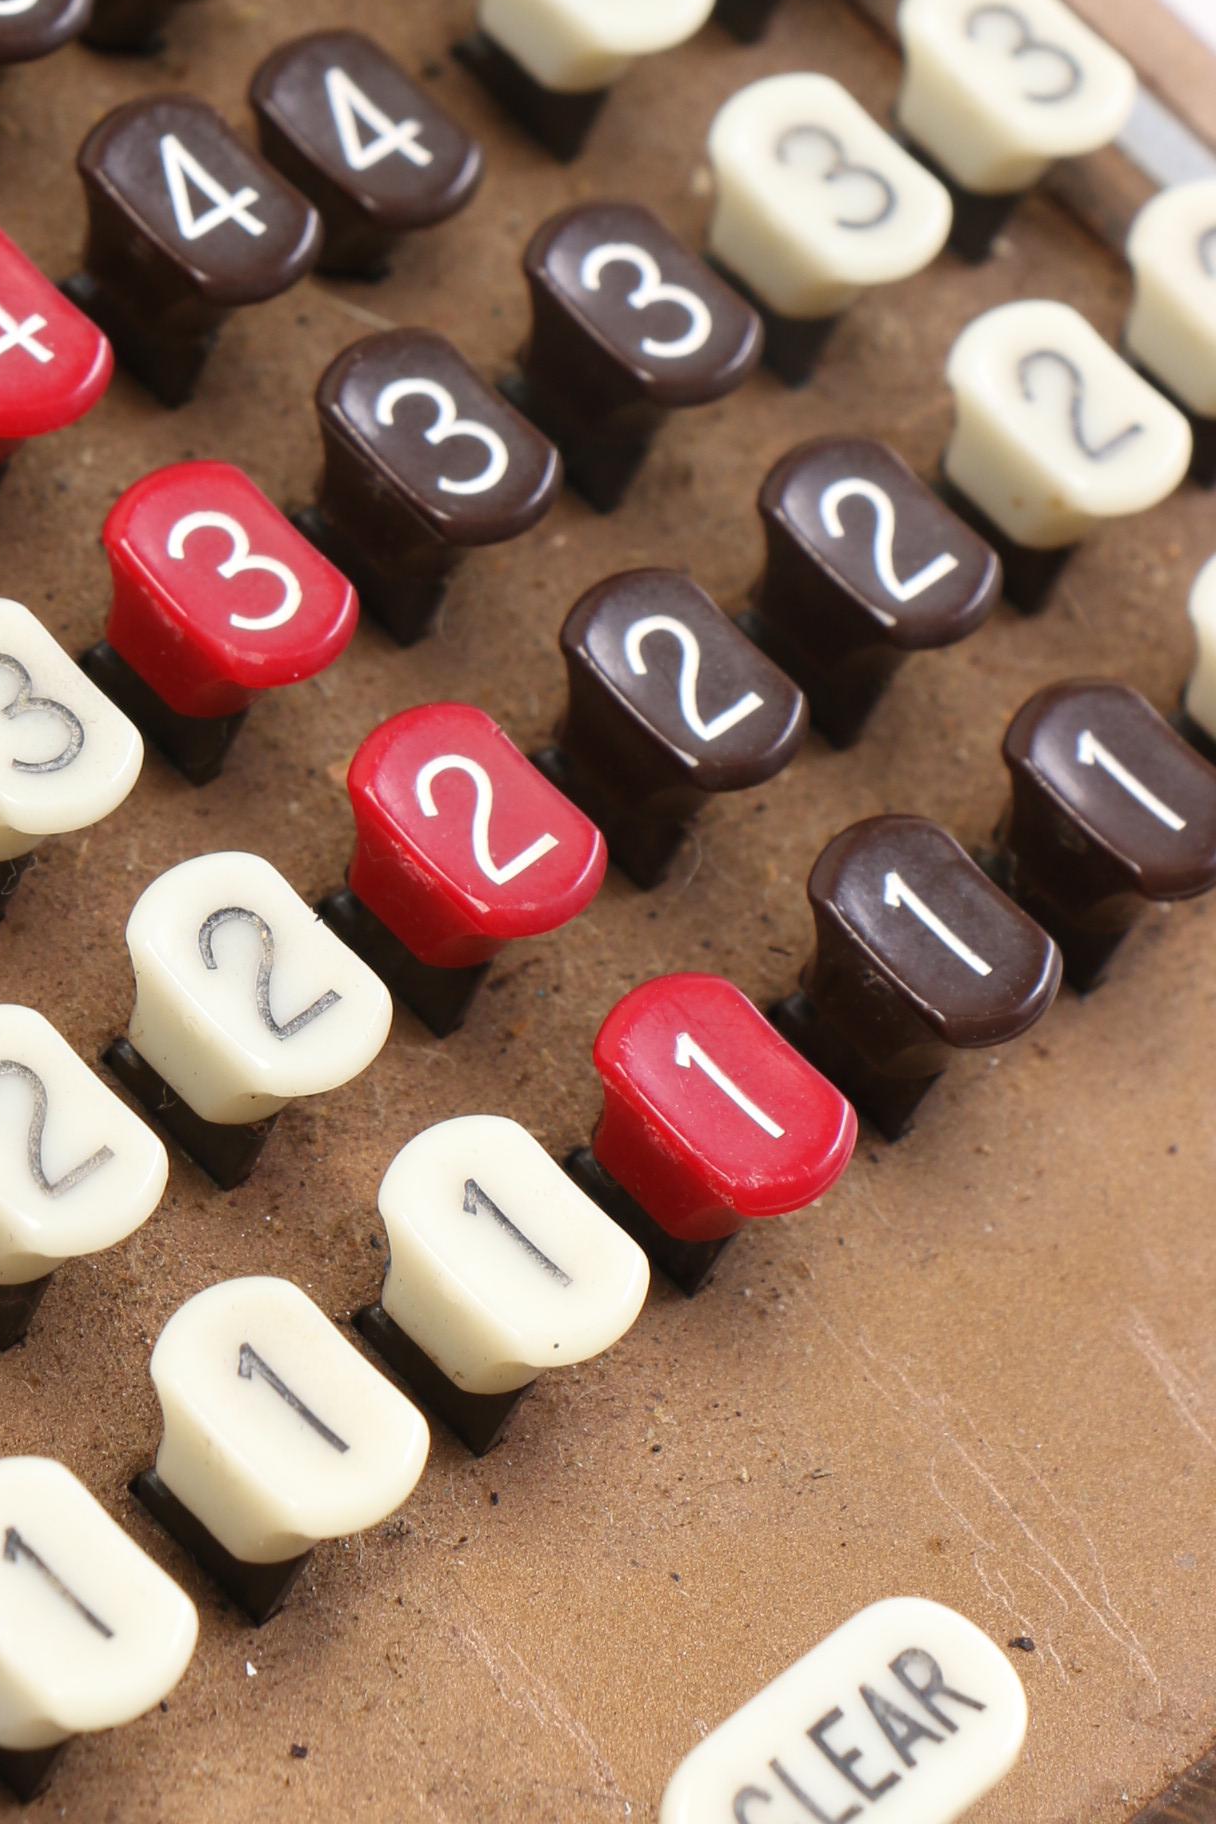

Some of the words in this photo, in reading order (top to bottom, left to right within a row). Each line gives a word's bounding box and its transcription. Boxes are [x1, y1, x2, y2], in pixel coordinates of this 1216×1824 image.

[964, 2, 1084, 106] 3
[327, 69, 430, 169] 4
[162, 136, 265, 239] 4
[774, 124, 899, 232] 3
[581, 244, 711, 357] 3
[376, 379, 507, 494] 3
[1016, 348, 1144, 463] 2
[167, 511, 301, 630] 3
[820, 479, 956, 601] 2
[625, 616, 762, 741] 2
[415, 755, 558, 884] 2
[1078, 731, 1184, 830] 1
[198, 905, 342, 1042] 2
[884, 872, 991, 975] 1
[675, 1033, 783, 1138] 1
[463, 1178, 571, 1286] 1
[237, 1342, 350, 1454] 1
[2, 1526, 114, 1639] 1
